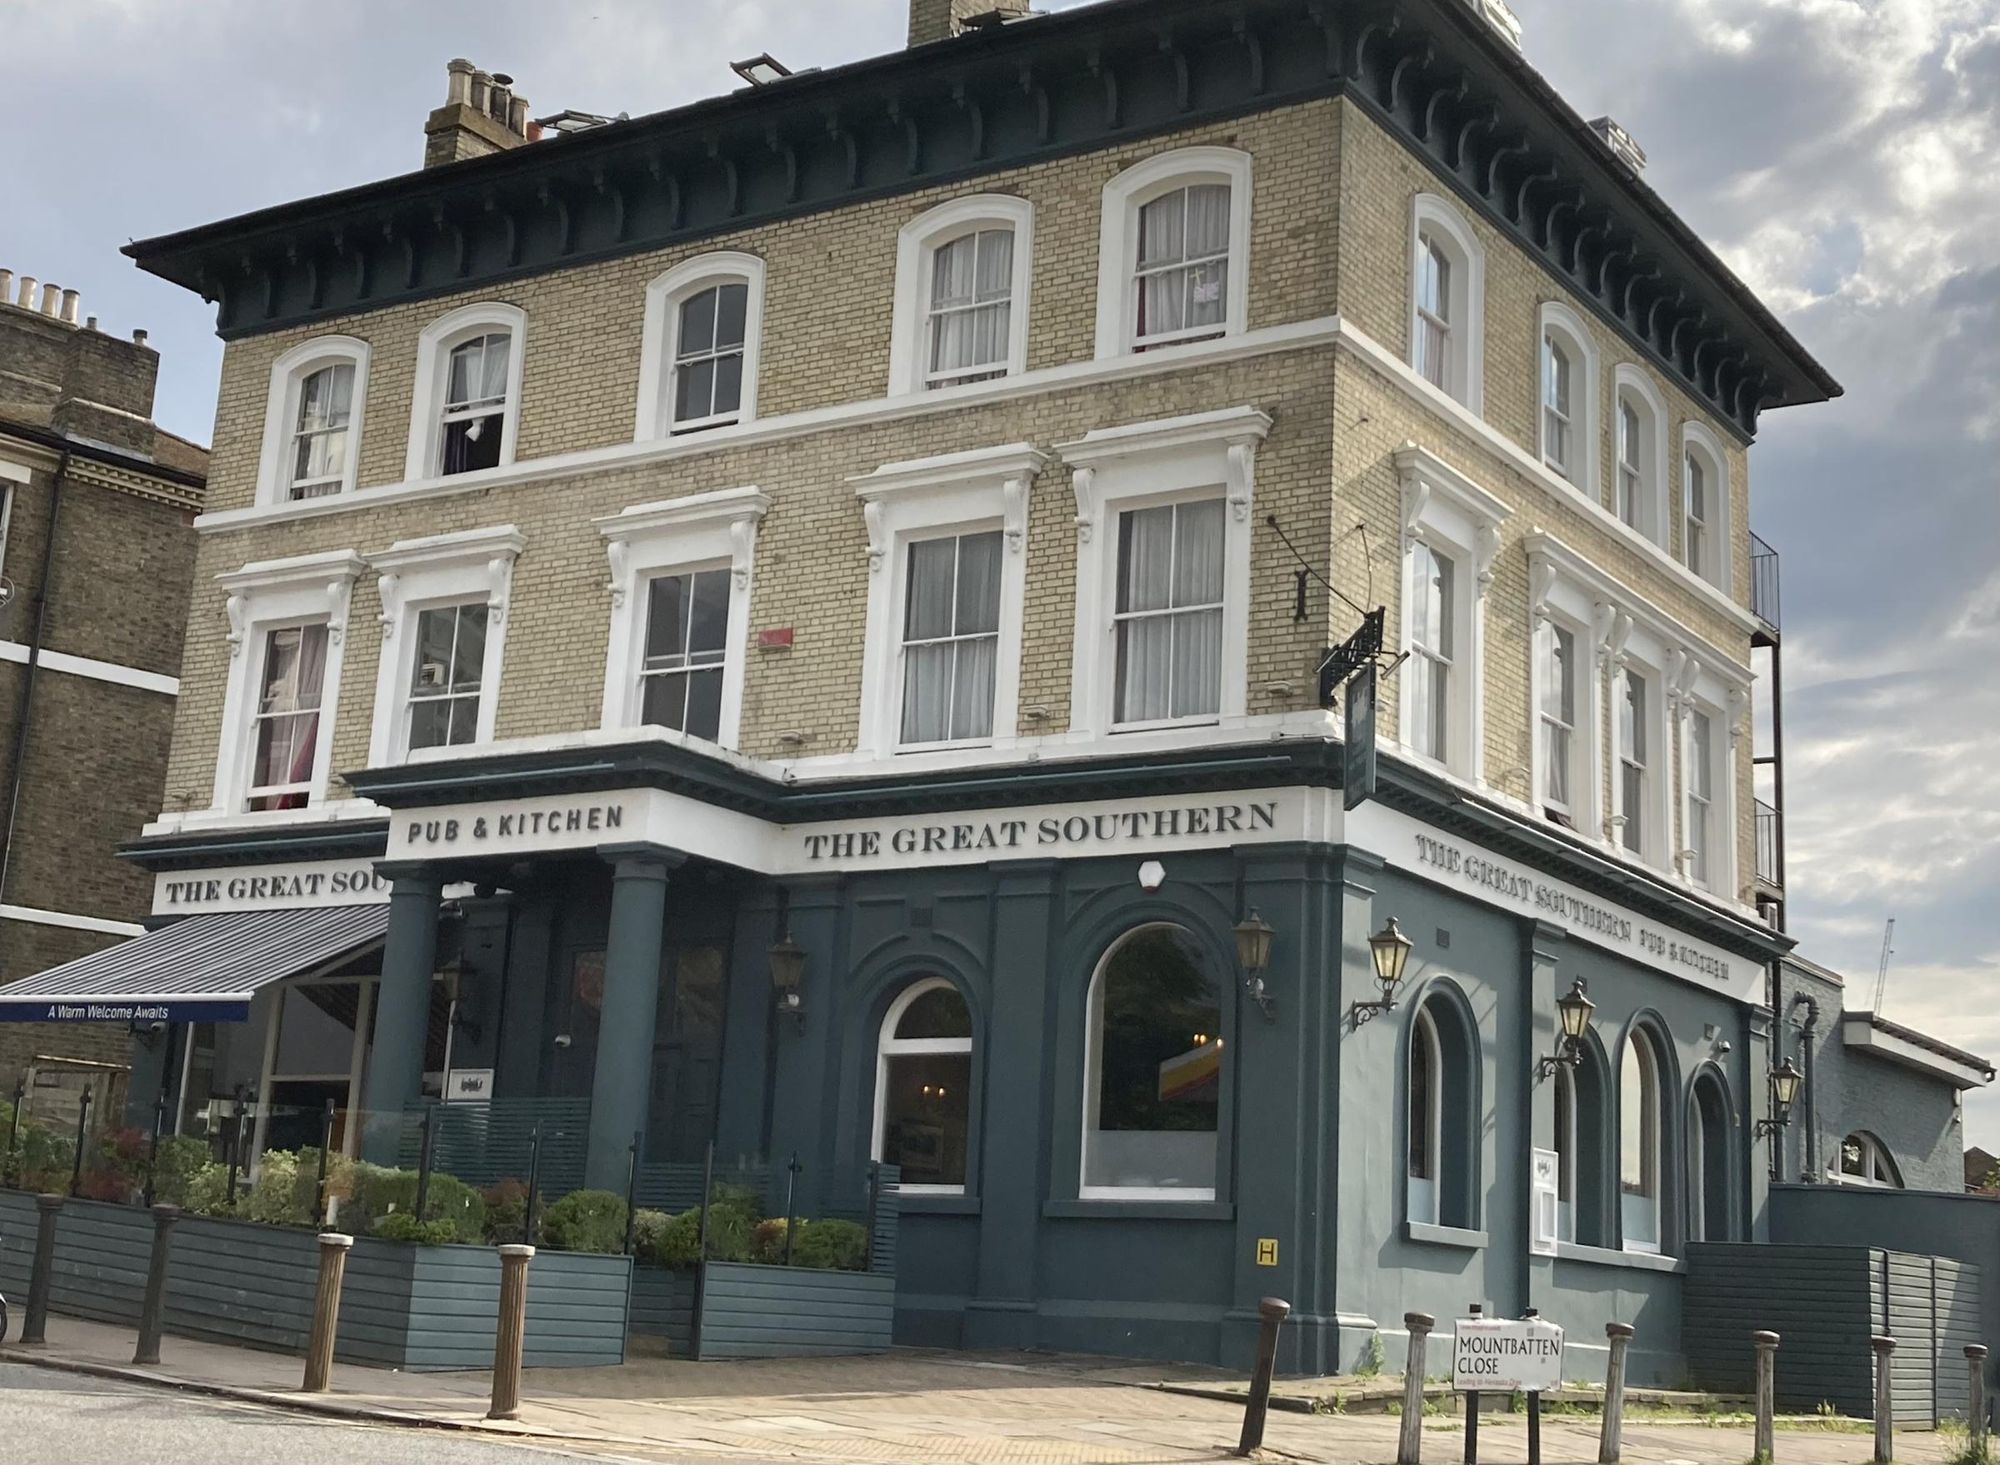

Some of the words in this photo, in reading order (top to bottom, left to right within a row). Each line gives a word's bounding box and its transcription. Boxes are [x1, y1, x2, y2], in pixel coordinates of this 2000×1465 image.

[408, 820, 459, 843] PUB
[473, 817, 487, 839] &
[498, 805, 622, 836] KITCHEN
[804, 831, 881, 859] THE
[892, 820, 1026, 853] GREAT
[1037, 802, 1278, 845] SOUTHERN
[166, 880, 221, 904] THE
[228, 873, 325, 900] GREAT
[1415, 834, 1461, 873] THE
[1464, 855, 1533, 902] GREAT
[1535, 884, 1631, 942] SOUTHERN
[1640, 929, 1666, 956] PUB
[47, 1005, 55, 1018] A
[57, 1005, 85, 1018] Warm
[87, 1005, 132, 1019] Welcome
[134, 1005, 168, 1019] Awaits
[1259, 1242, 1275, 1262] H
[1459, 1336, 1560, 1356] MOUNTBATTEN
[1458, 1357, 1499, 1374] CLOSE
